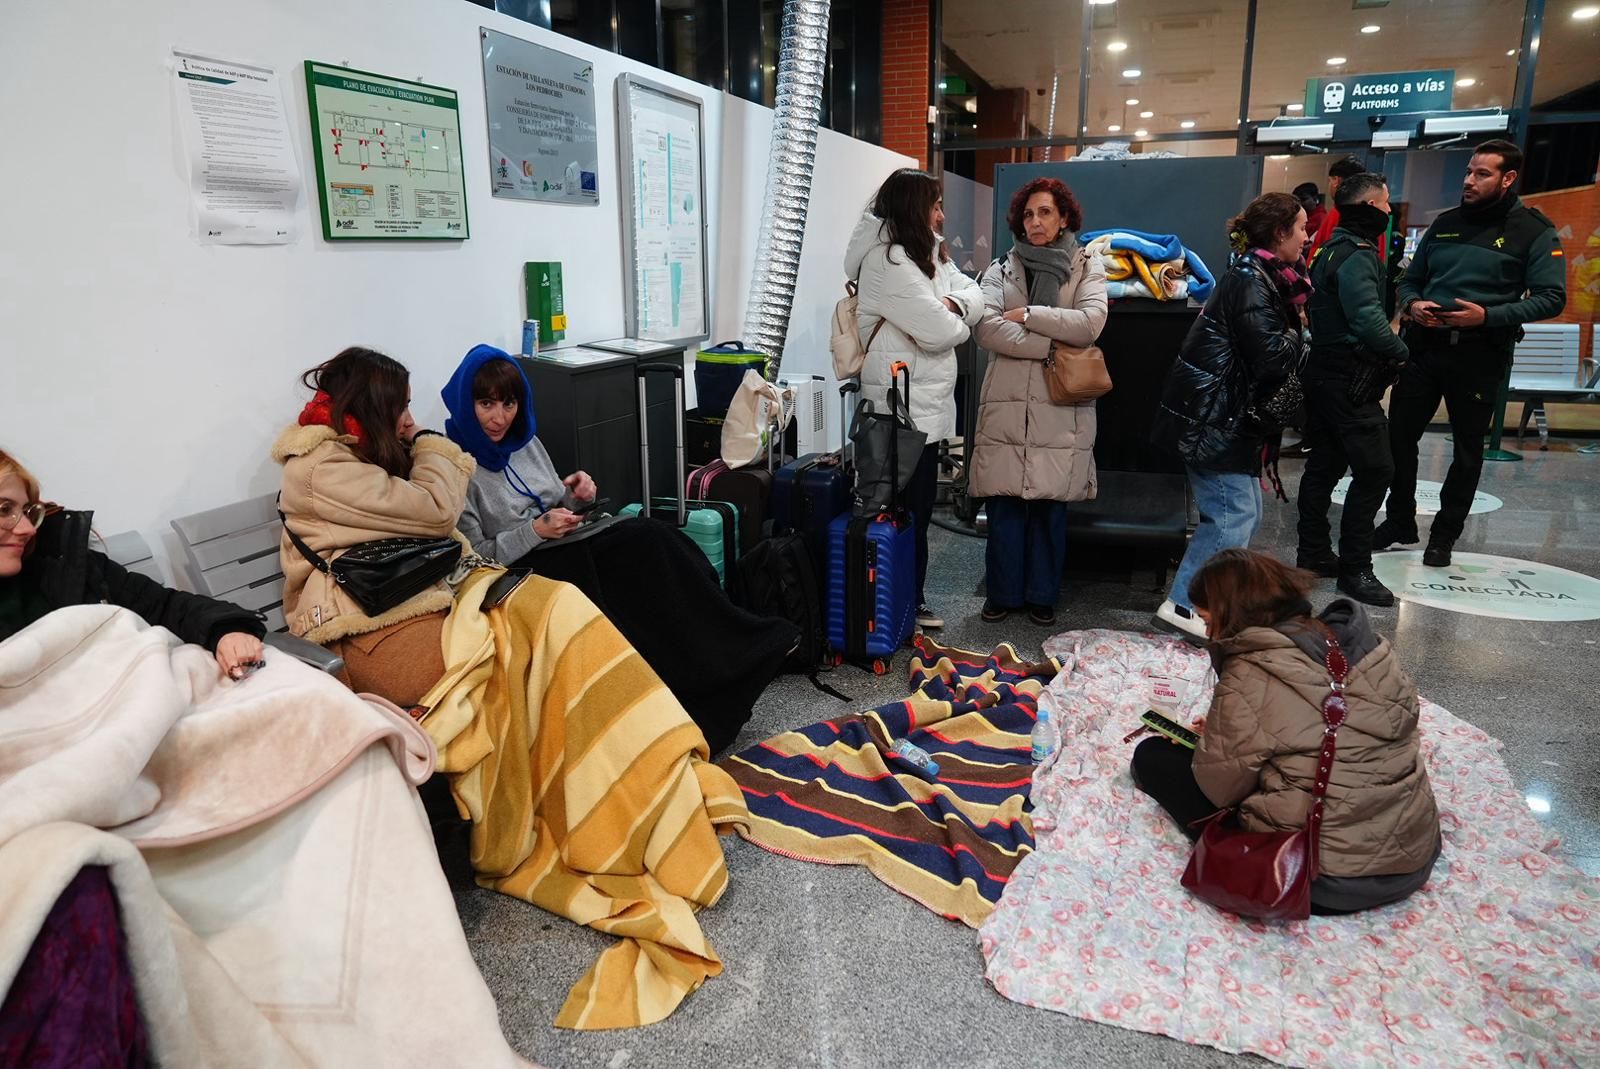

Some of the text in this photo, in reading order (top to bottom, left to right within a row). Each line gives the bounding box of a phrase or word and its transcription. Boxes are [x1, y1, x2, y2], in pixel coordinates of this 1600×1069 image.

[343, 79, 359, 89] PLANO
[360, 83, 367, 91] DE
[368, 84, 394, 96] EVACUACIÓN
[399, 90, 423, 101] EVACUATION
[424, 95, 435, 103] PLAN
[526, 82, 535, 91] LOS
[1352, 78, 1445, 96] Acceso a vías
[1351, 99, 1399, 110] PLATFORMS
[1411, 582, 1577, 601] CONECTADA
[1154, 689, 1177, 698] NATURAL
